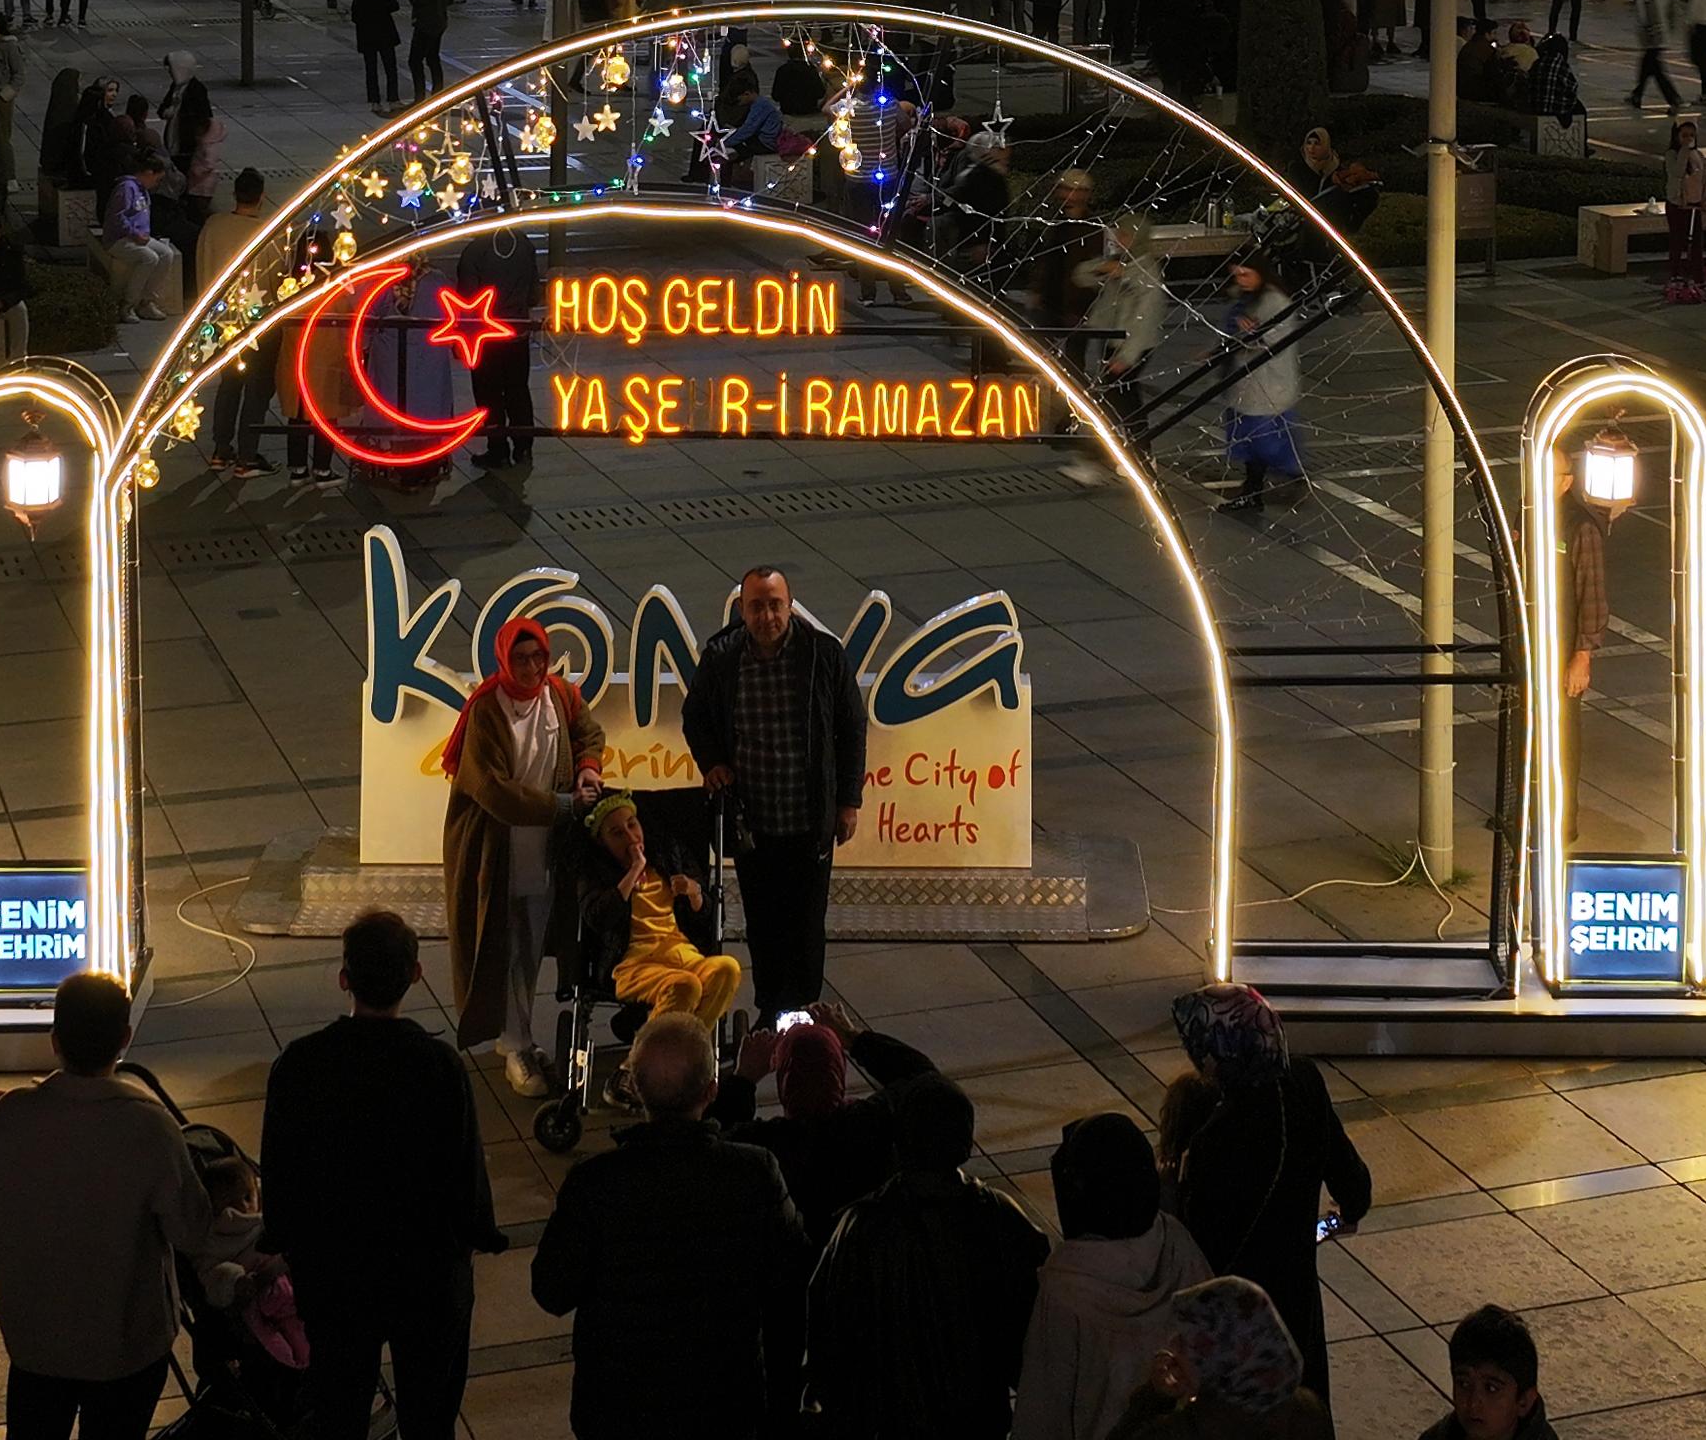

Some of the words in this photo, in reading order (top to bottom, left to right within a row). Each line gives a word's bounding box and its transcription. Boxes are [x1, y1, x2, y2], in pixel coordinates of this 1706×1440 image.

[553, 277, 649, 344] HOŞ
[662, 271, 836, 336] GELDİN
[805, 379, 1040, 437] RAMAZAN
[904, 748, 977, 806] City
[987, 748, 1022, 789] of
[878, 802, 979, 845] Hearts
[1570, 891, 1679, 922] BENİM
[1569, 924, 1678, 955] ŞEHRİM
